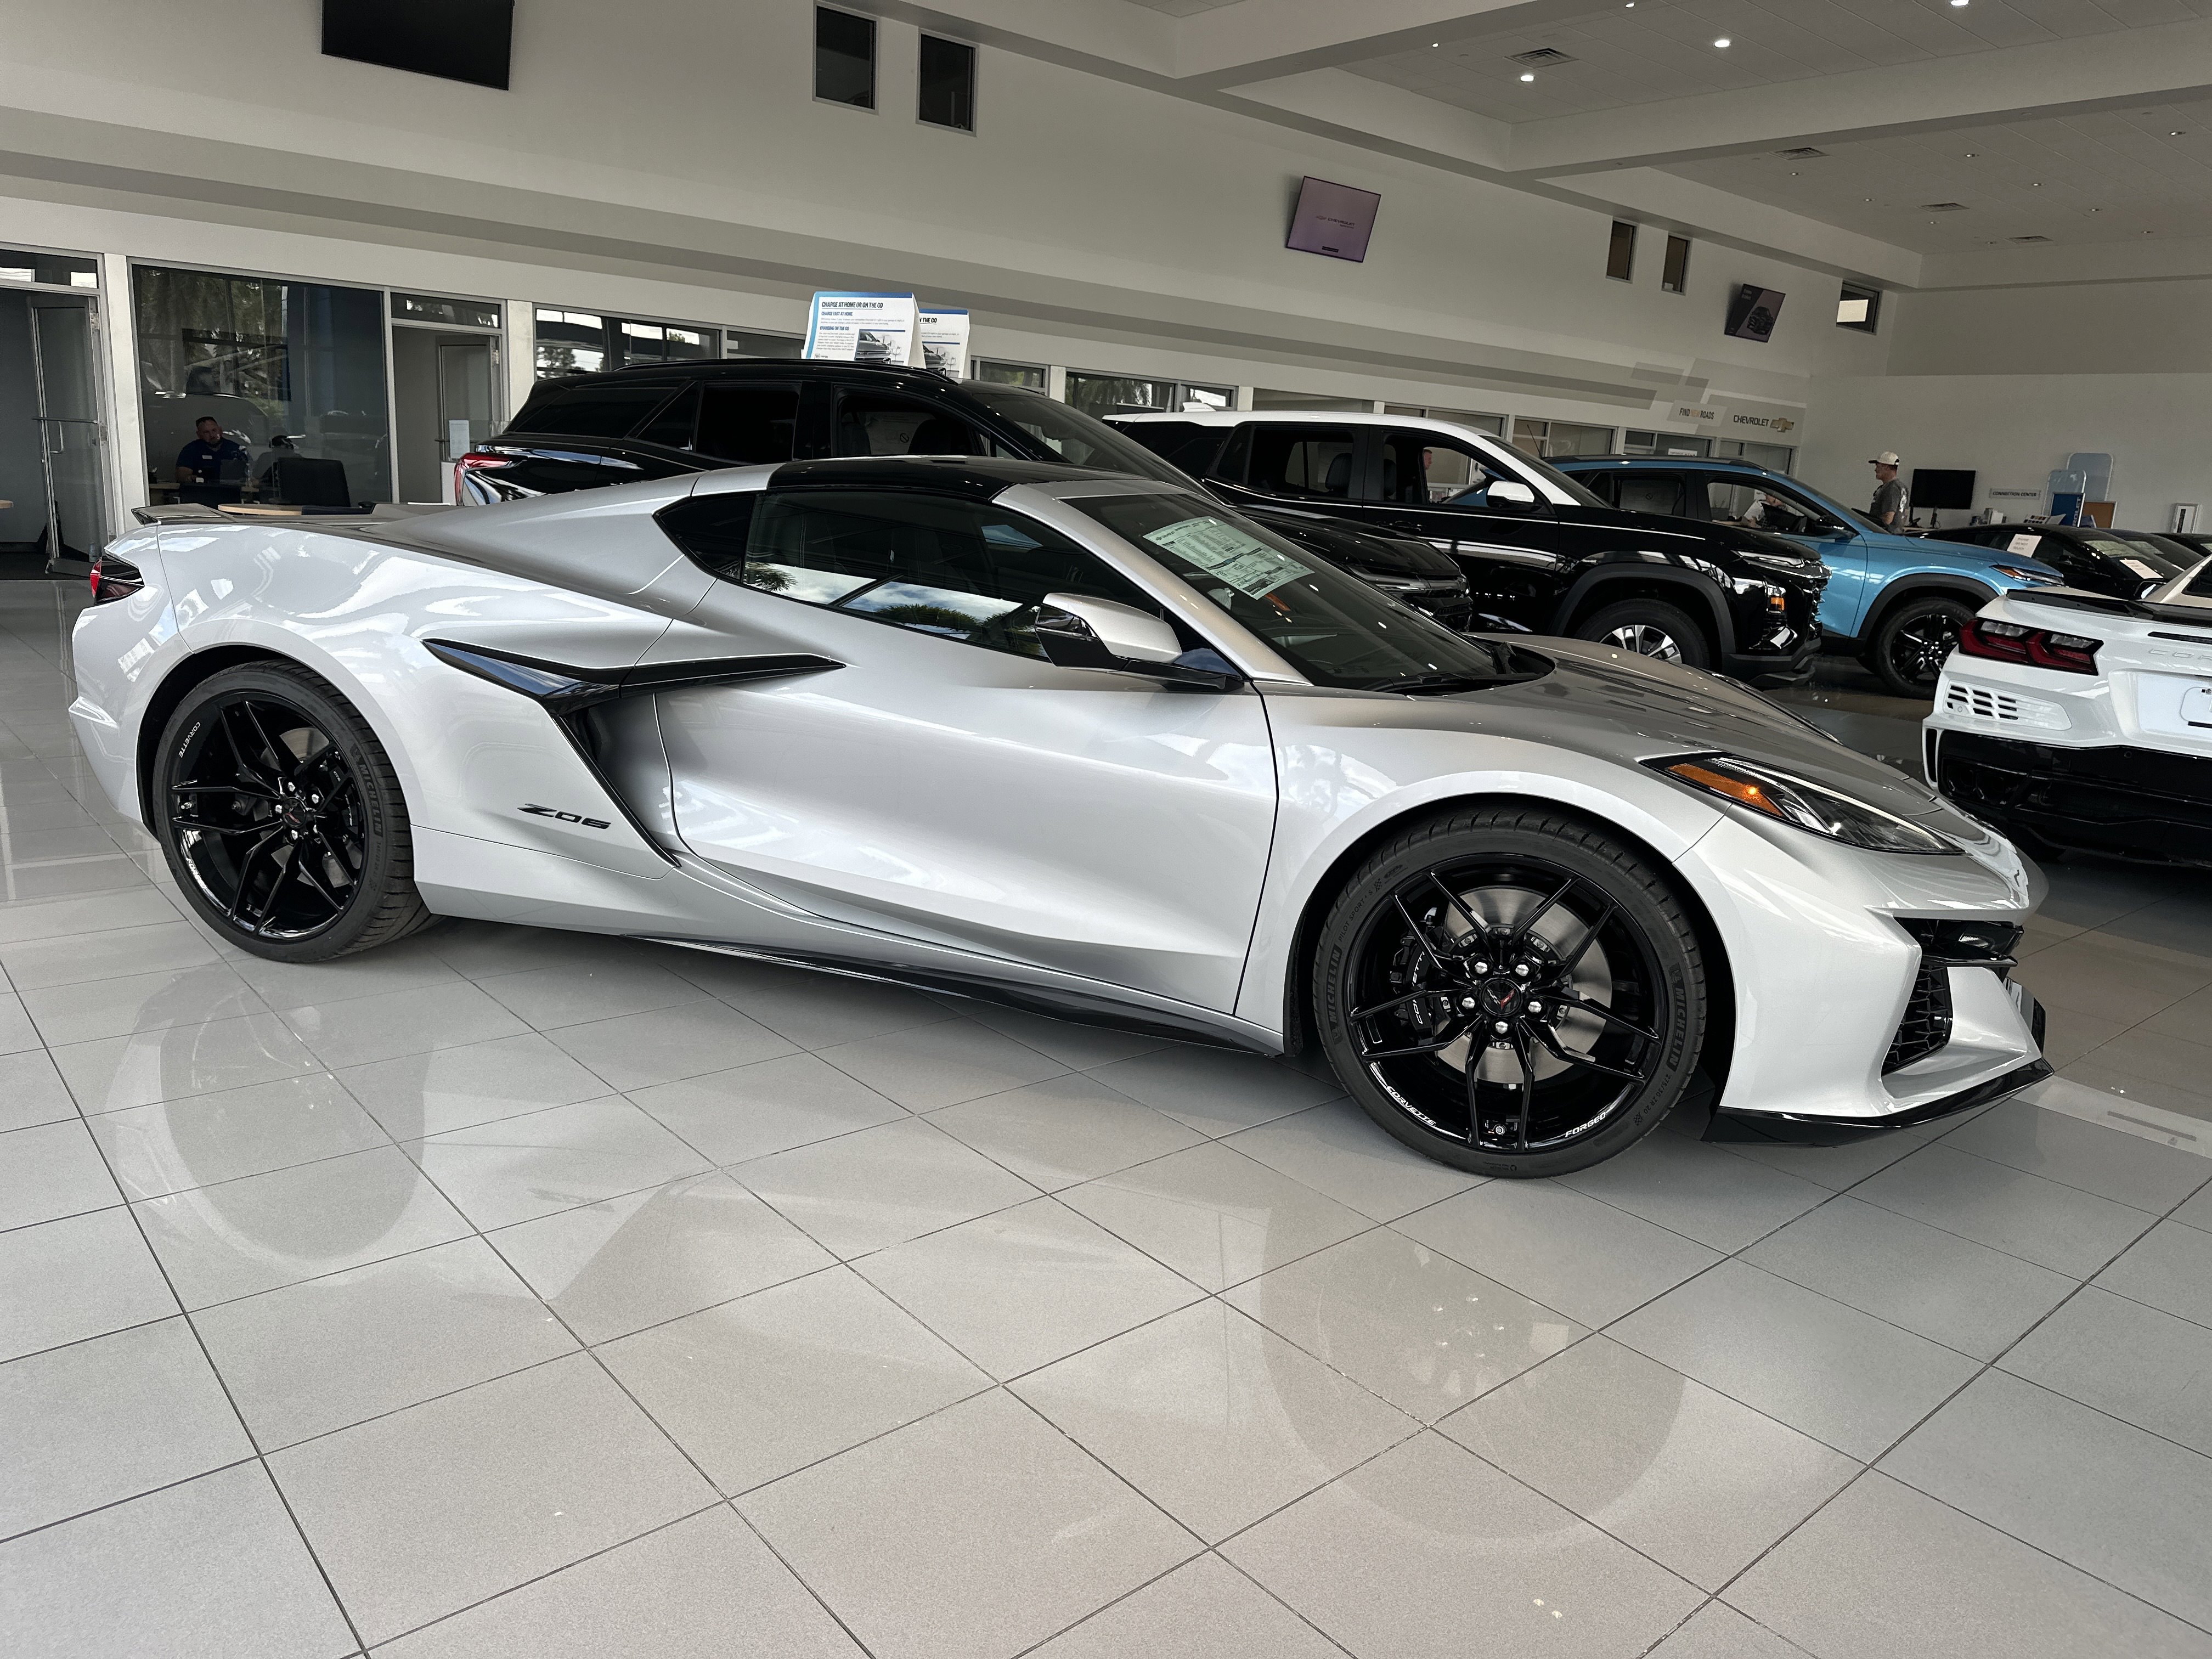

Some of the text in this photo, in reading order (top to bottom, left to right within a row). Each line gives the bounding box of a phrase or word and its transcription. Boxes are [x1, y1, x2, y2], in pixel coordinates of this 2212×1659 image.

[1679, 408, 1690, 417] FIND
[1700, 410, 1714, 420] ROADS
[1733, 414, 1769, 427] CHEVROLET
[179, 721, 201, 758] CORVETTE
[359, 764, 382, 833] MICHELIN
[517, 803, 612, 830] Z06
[1339, 921, 1350, 942] PILOT
[1349, 898, 1365, 921] SPORT
[1327, 950, 1341, 1023] MICHELIN
[1669, 988, 1685, 1068] MICHELIN
[1656, 1074, 1671, 1097] 275/30
[1386, 1086, 1437, 1126] CORVETTE
[1565, 1111, 1606, 1138] FORGED
